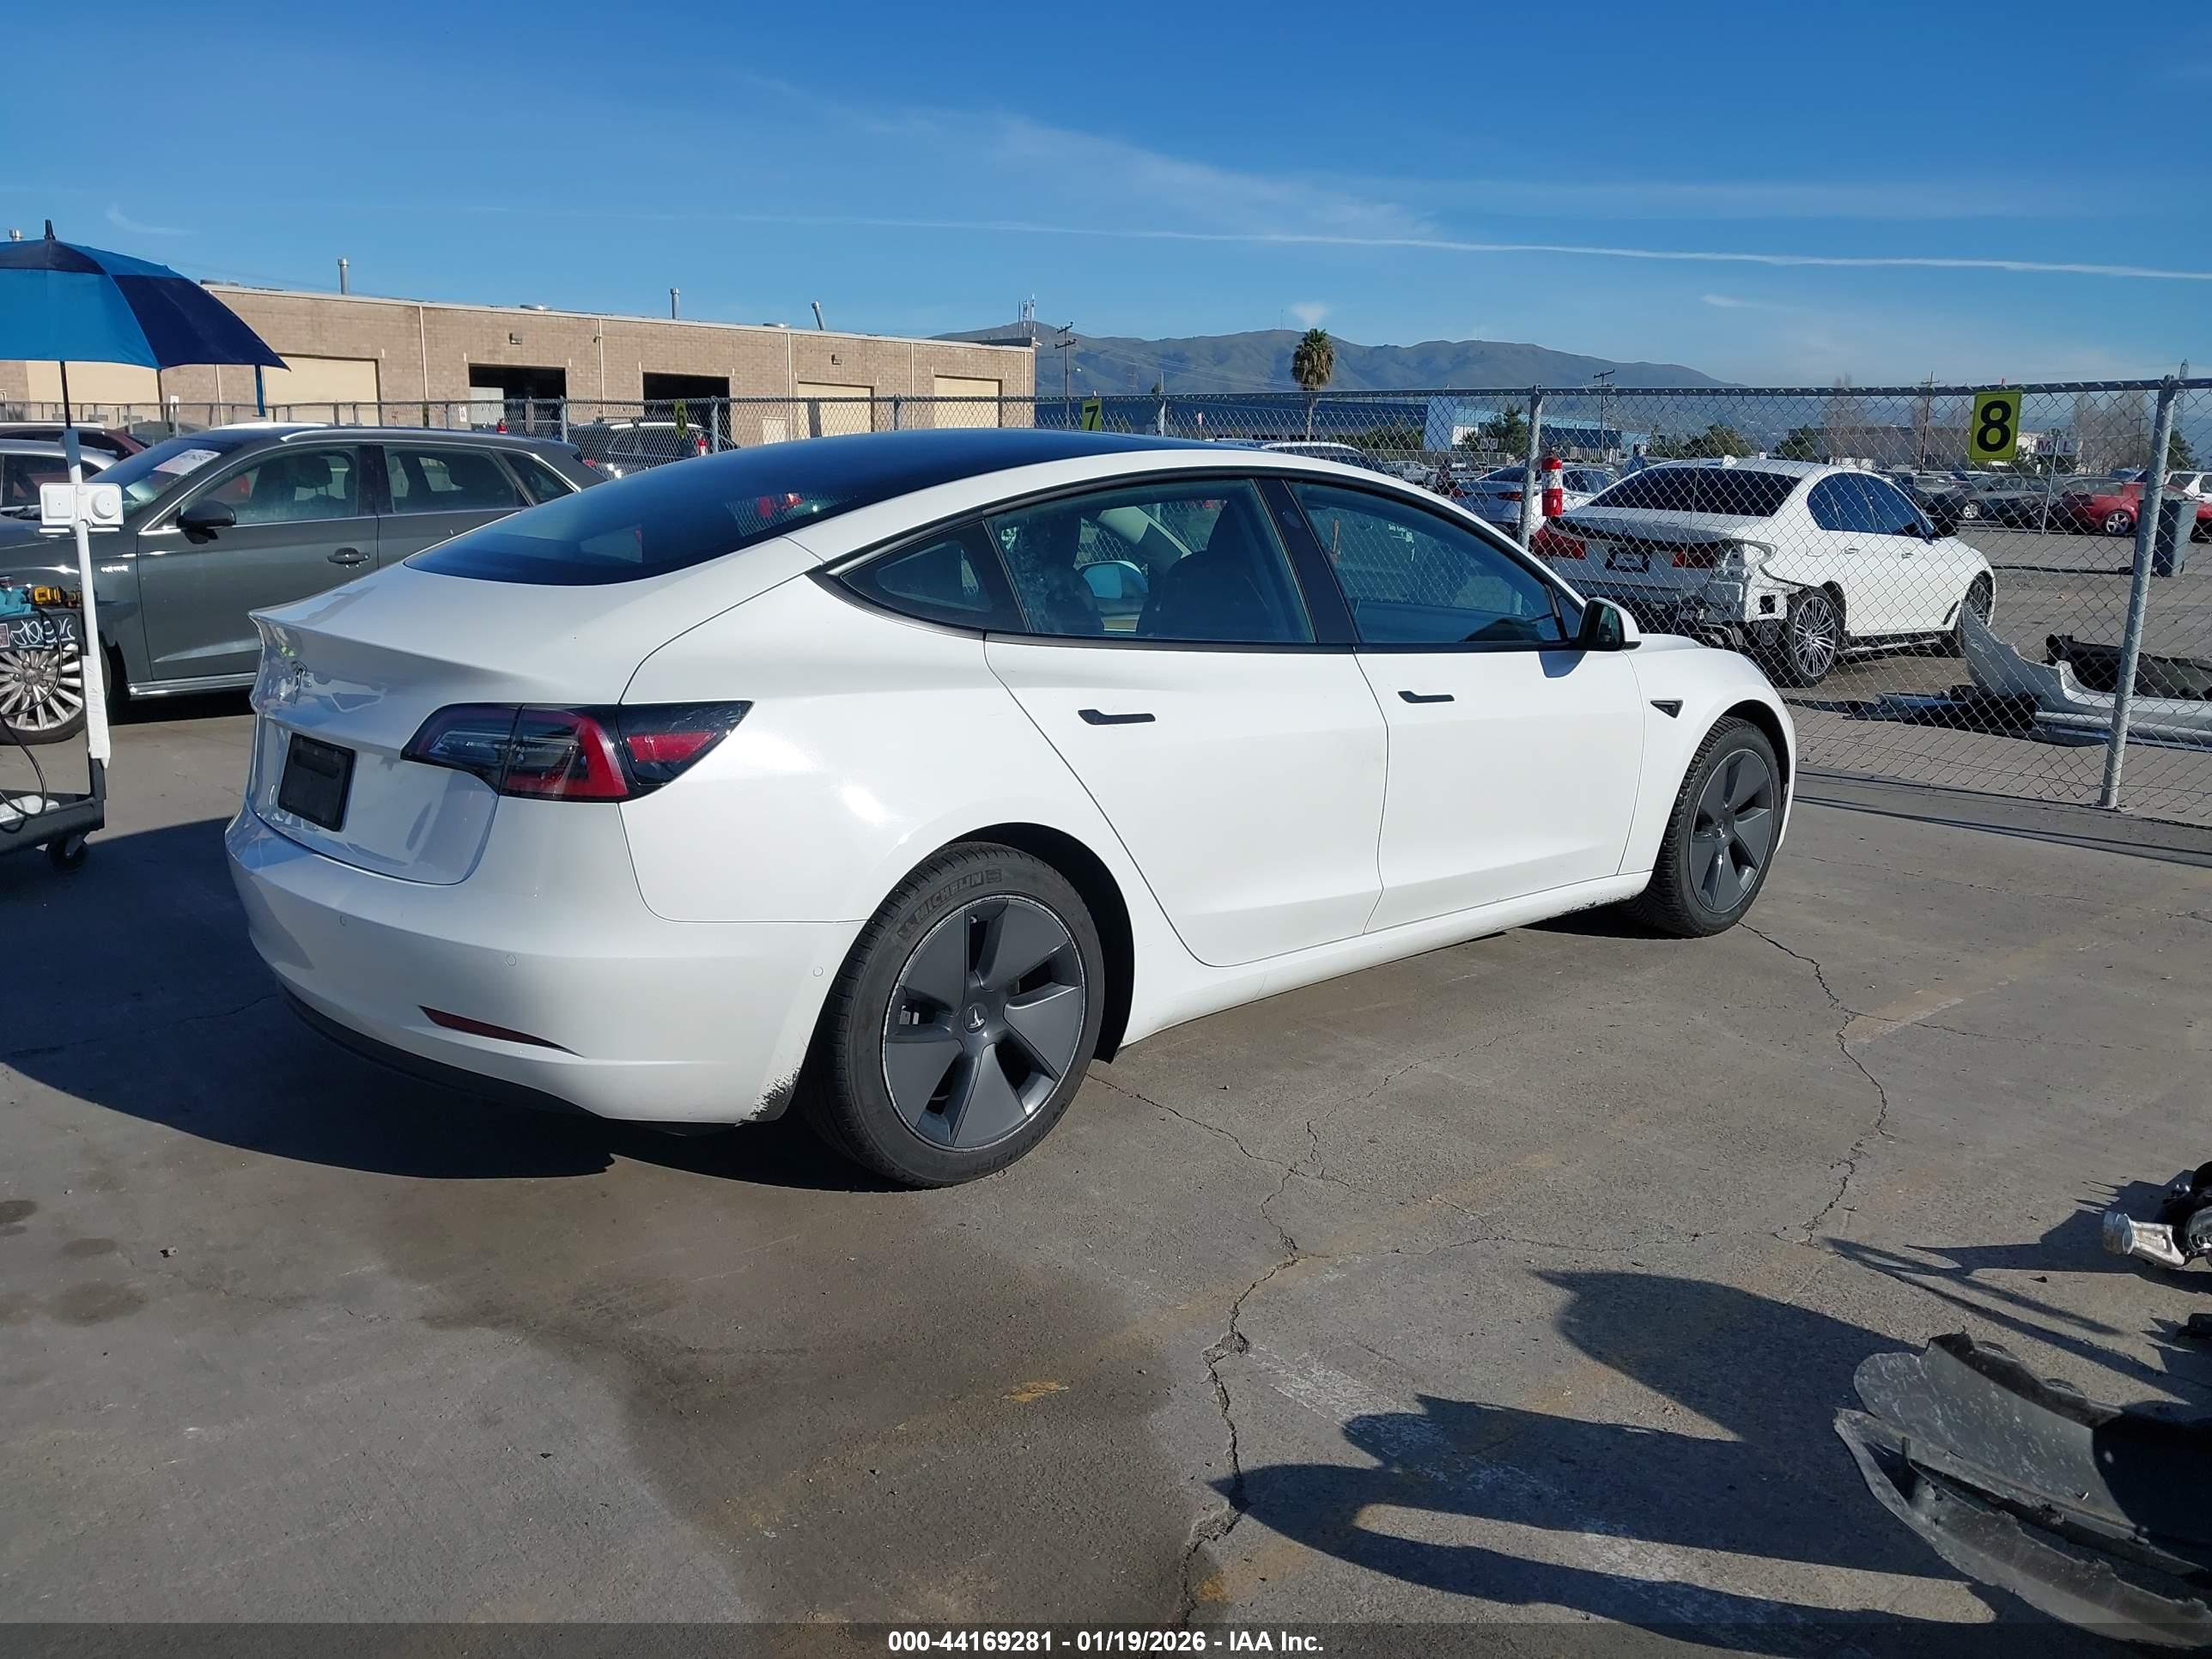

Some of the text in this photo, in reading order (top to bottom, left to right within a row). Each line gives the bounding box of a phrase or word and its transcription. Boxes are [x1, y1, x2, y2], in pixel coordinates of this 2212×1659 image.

[678, 406, 685, 430] 6
[1085, 405, 1099, 431] 7
[1977, 400, 2012, 453] 8
[2037, 441, 2071, 453] M L
